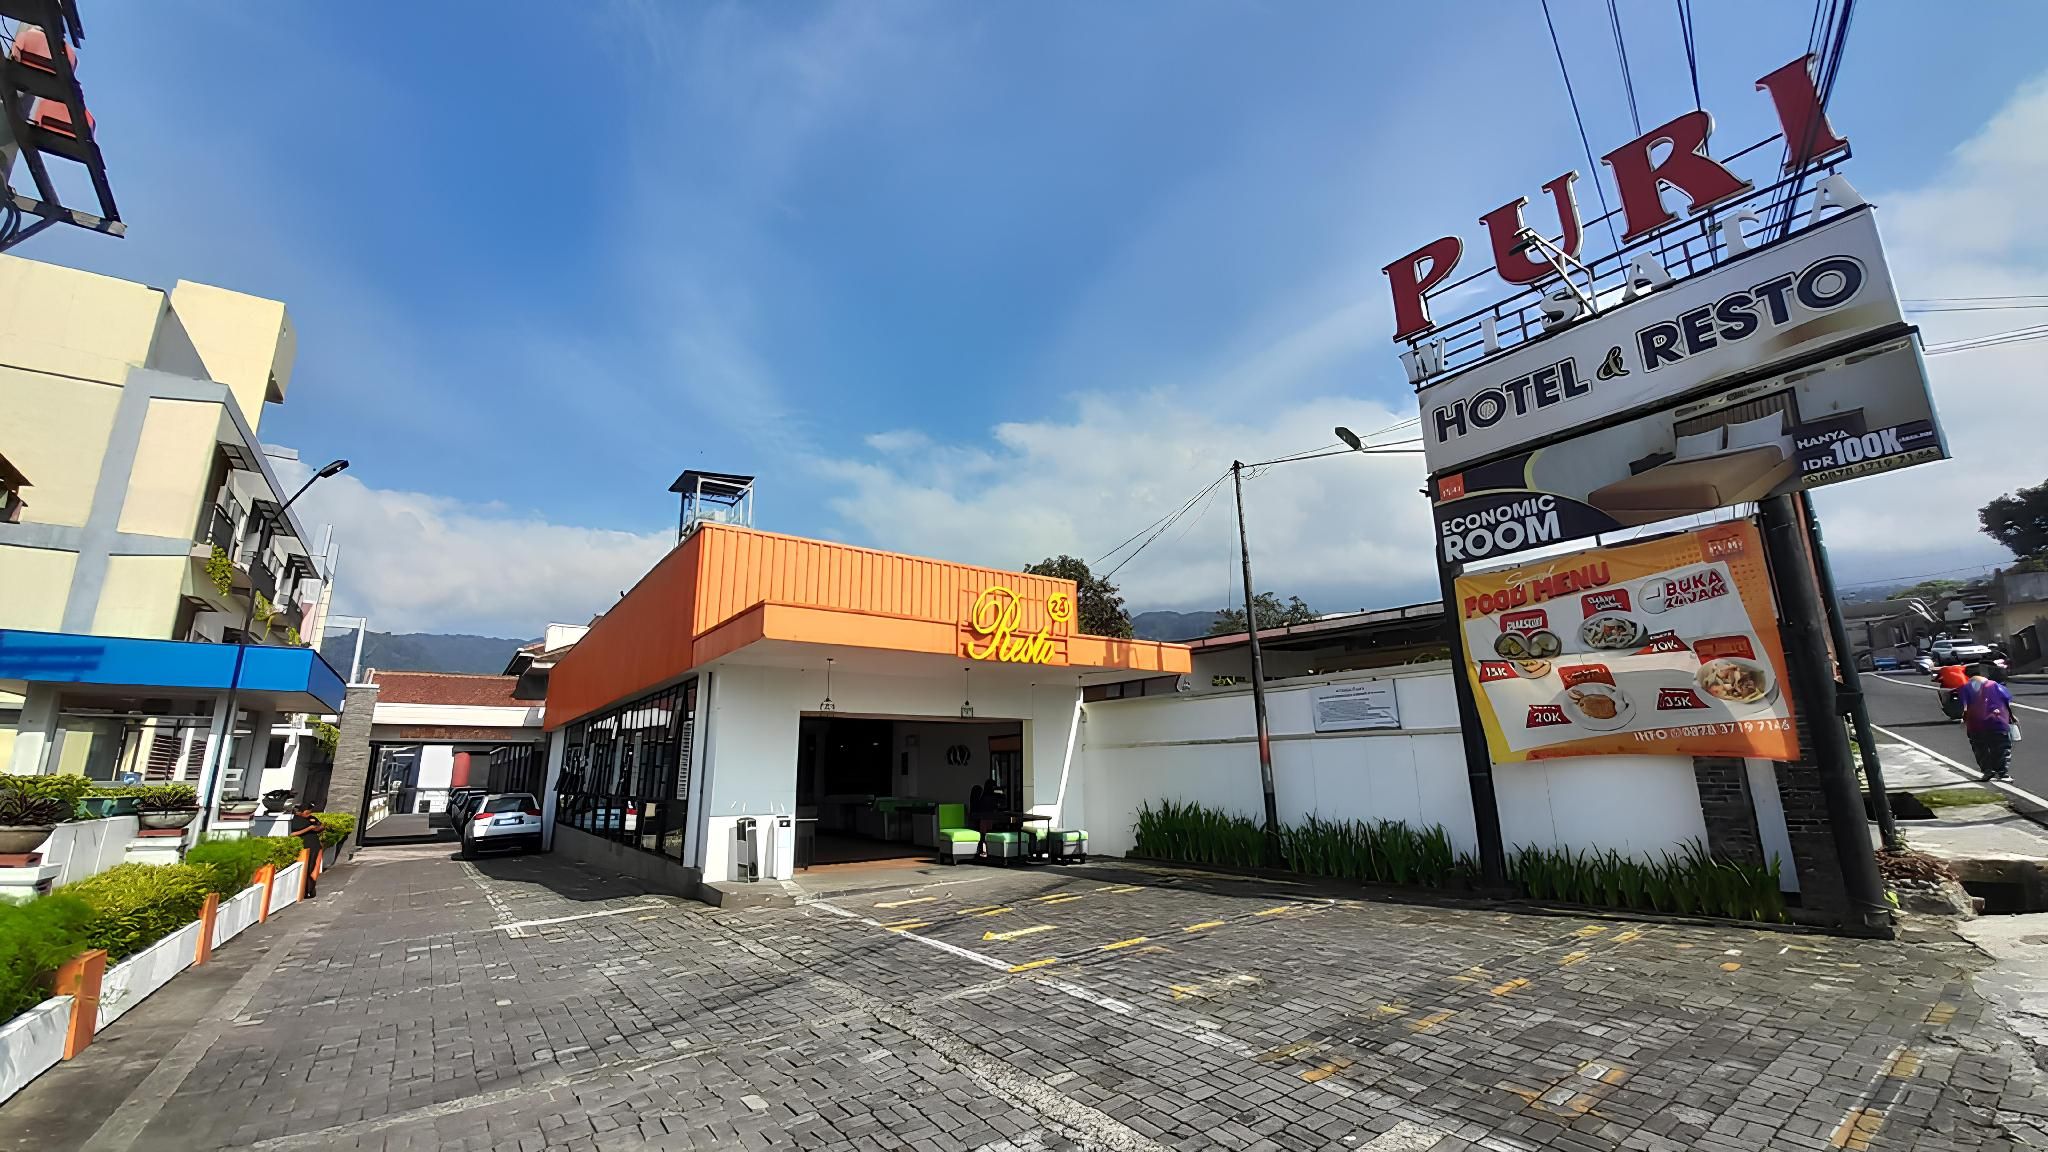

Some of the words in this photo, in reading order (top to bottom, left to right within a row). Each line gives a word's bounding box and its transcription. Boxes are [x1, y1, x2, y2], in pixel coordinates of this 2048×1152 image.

[1383, 53, 1850, 343] PURI
[1433, 357, 1591, 443] HOTEL
[1597, 346, 1630, 381] &
[1636, 254, 1868, 374] RESTO
[1797, 430, 1850, 449] HANYA
[1803, 456, 1835, 471] IDR
[1830, 427, 1903, 466] 100K
[1441, 494, 1556, 536] ECONOMIC
[1443, 510, 1561, 563] ROOM
[1464, 584, 1527, 618] FOOD
[1533, 561, 1611, 602] MENU
[1666, 569, 1723, 597] BUKA
[968, 586, 1056, 664] Resto
